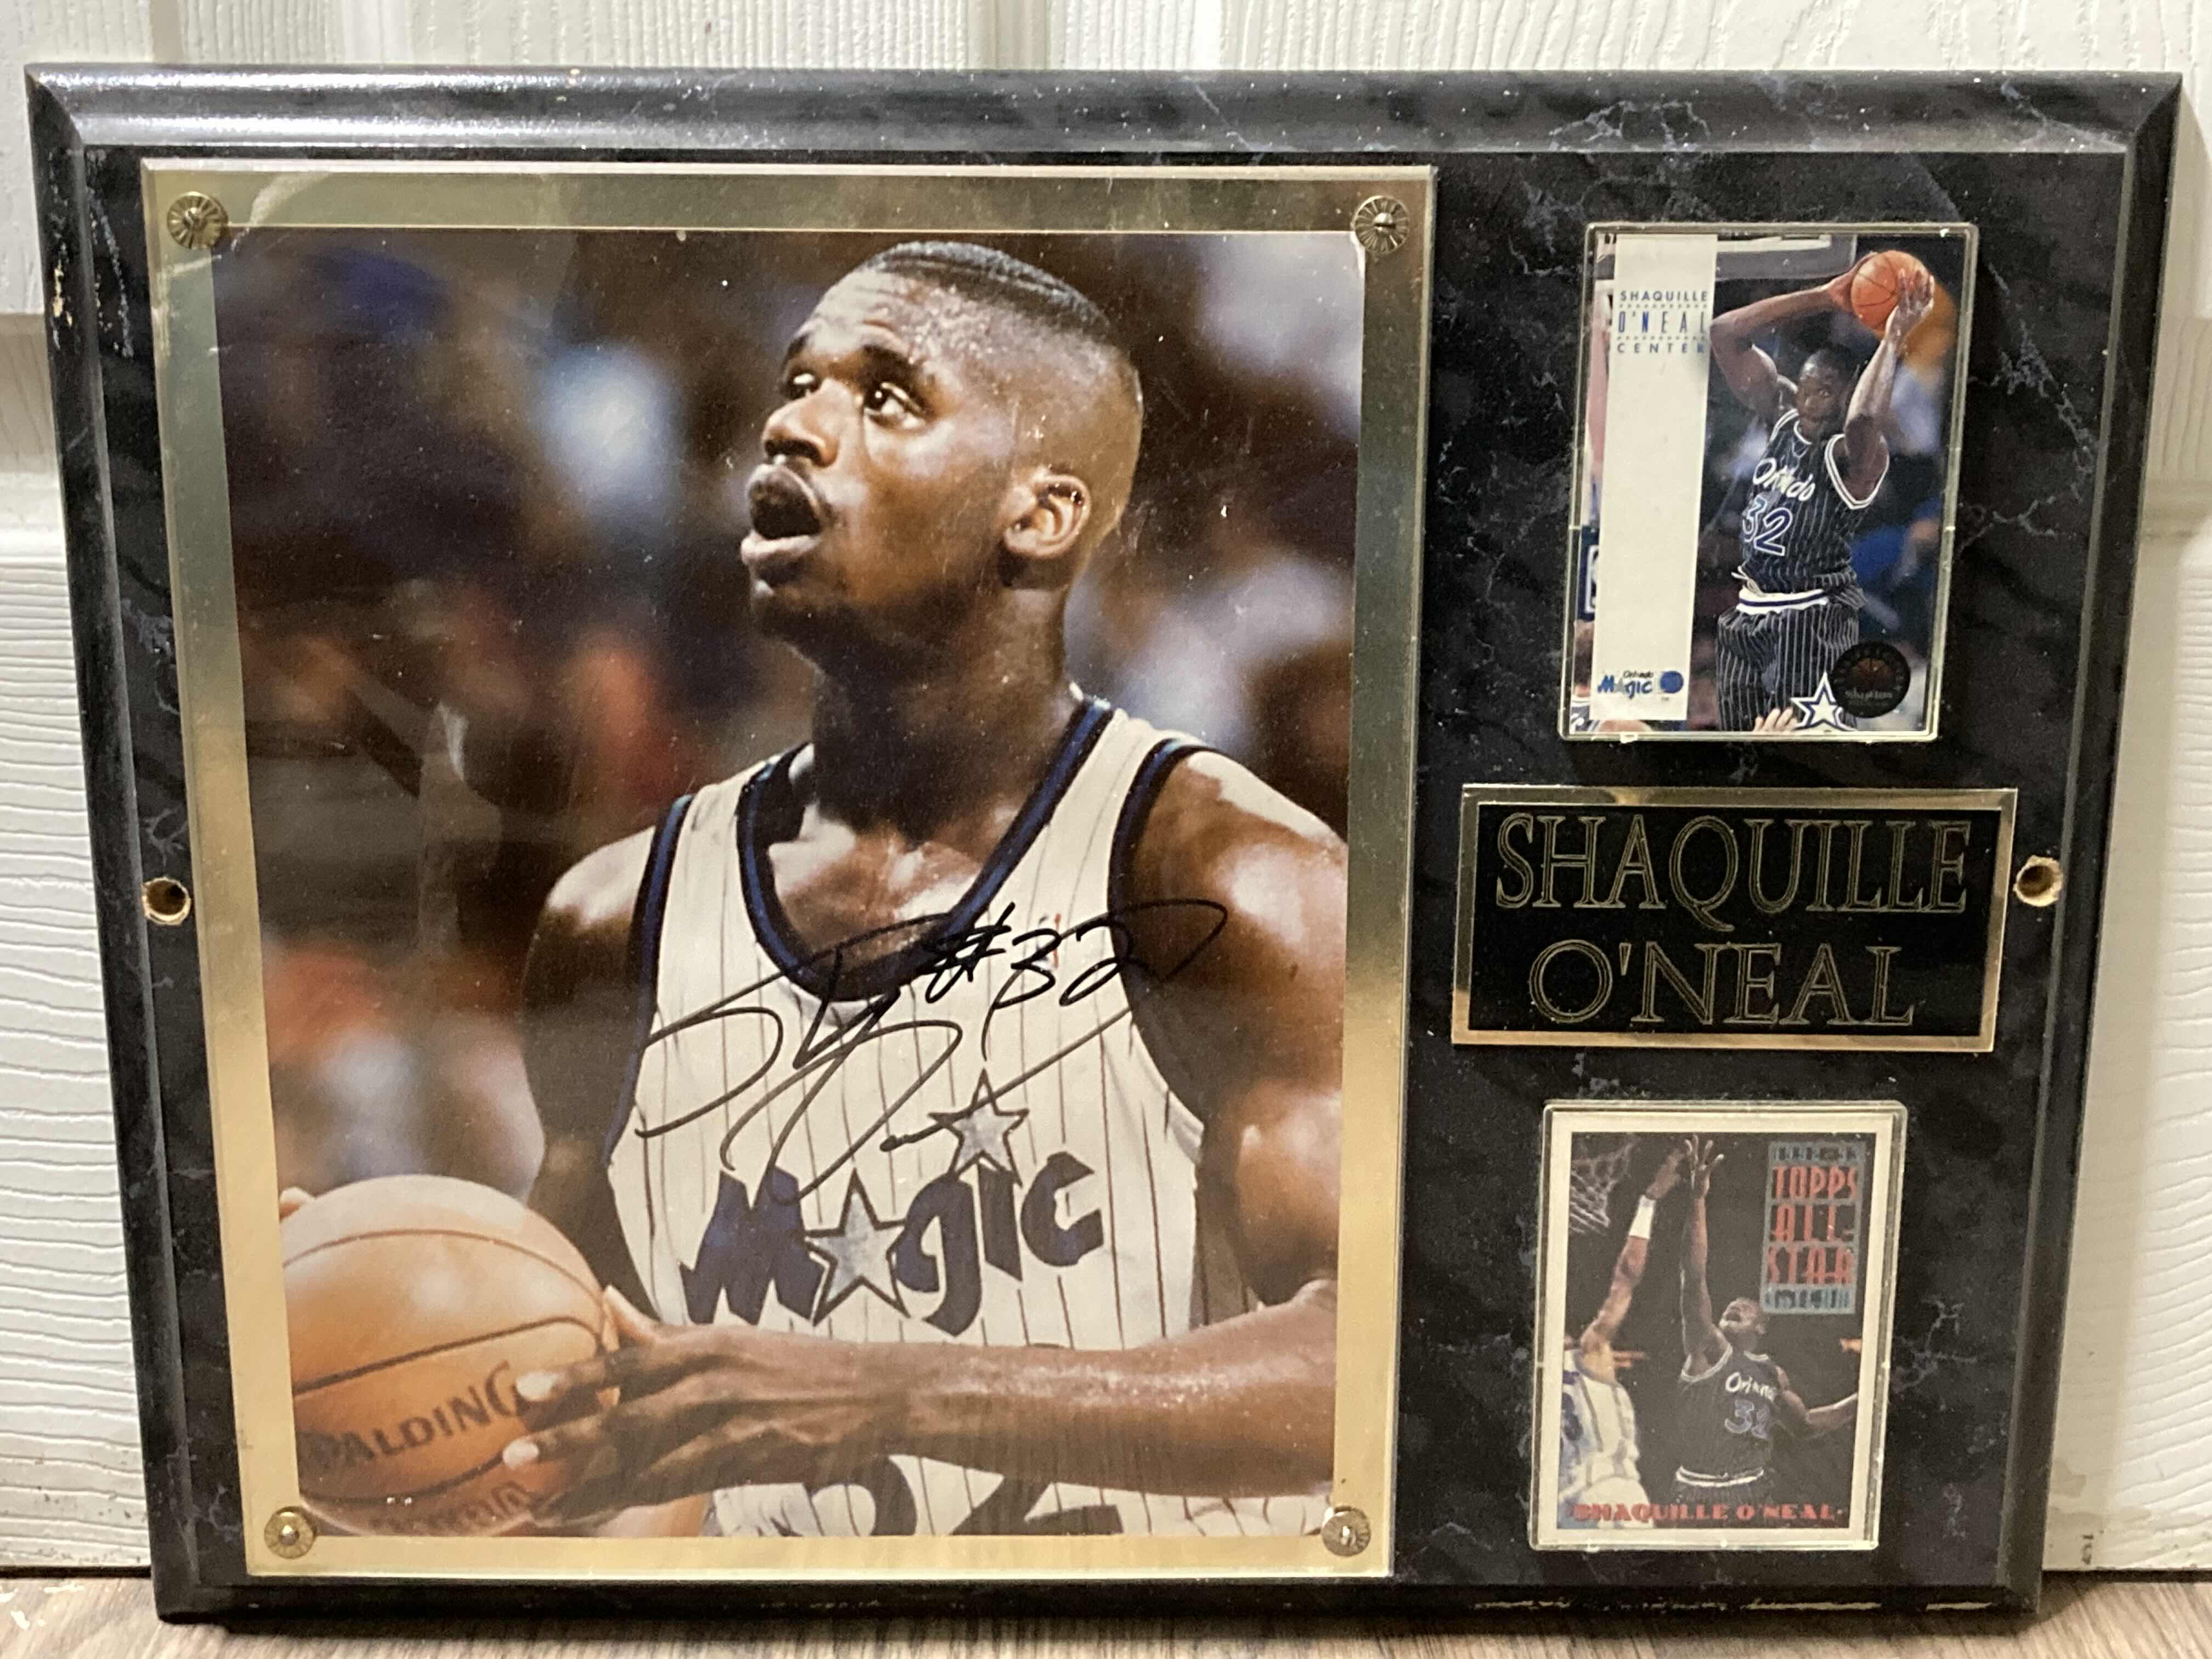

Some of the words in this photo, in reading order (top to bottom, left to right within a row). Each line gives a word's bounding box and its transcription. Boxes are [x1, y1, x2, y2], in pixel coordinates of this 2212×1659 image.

[1620, 290, 1708, 302] SHAQUILLE
[1617, 311, 1706, 334] O'NEAL
[1617, 342, 1705, 354] CENTER
[1742, 494, 1793, 557] 32
[1496, 811, 1971, 932] SHAQUILLE
[1528, 939, 1916, 1026] O'NEAL
[1773, 1165, 1858, 1201] TOPPS
[1572, 1503, 1728, 1522] SHAQUILLE
